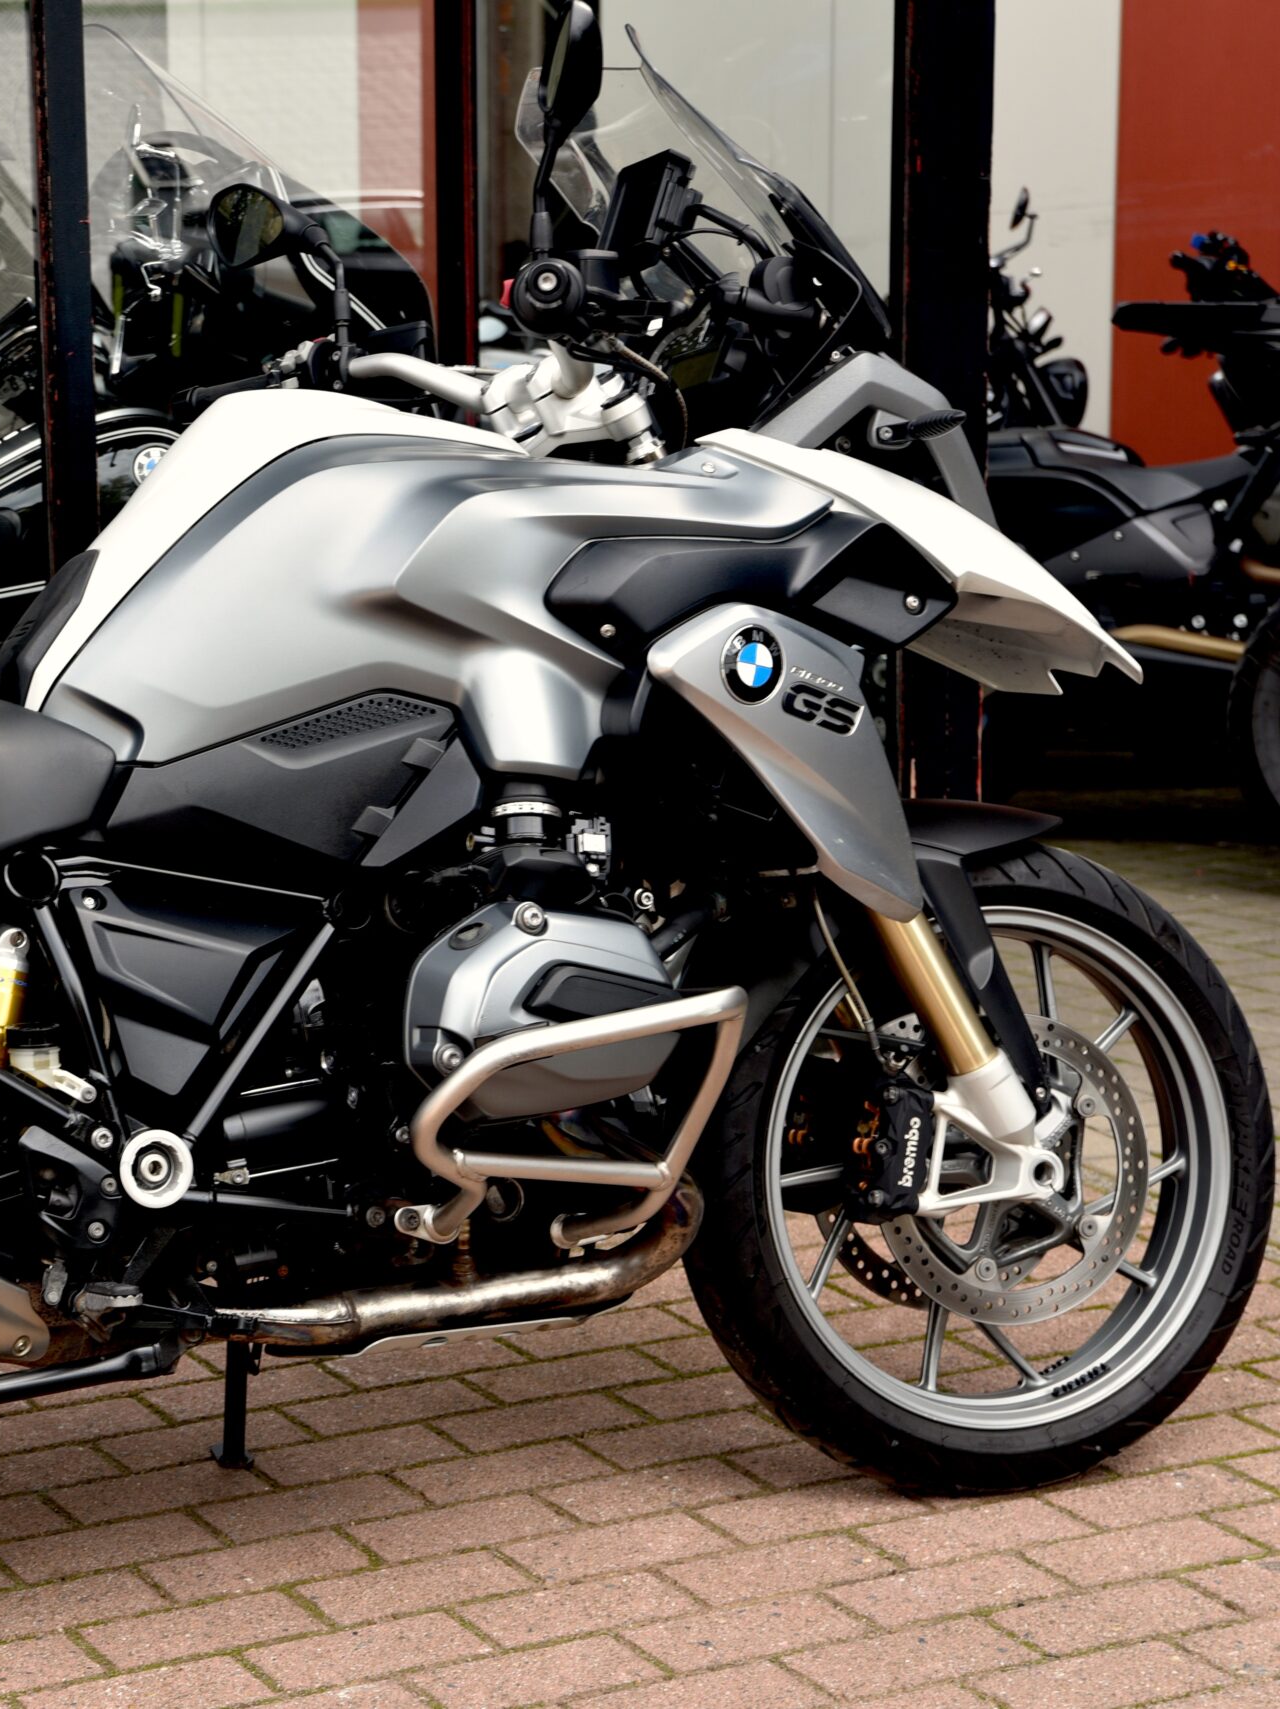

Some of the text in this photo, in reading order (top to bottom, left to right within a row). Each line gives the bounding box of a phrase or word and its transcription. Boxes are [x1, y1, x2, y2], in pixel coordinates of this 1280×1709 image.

[781, 683, 863, 736] GS
[898, 1116, 922, 1188] brembo
[1221, 1215, 1245, 1277] ROAD
